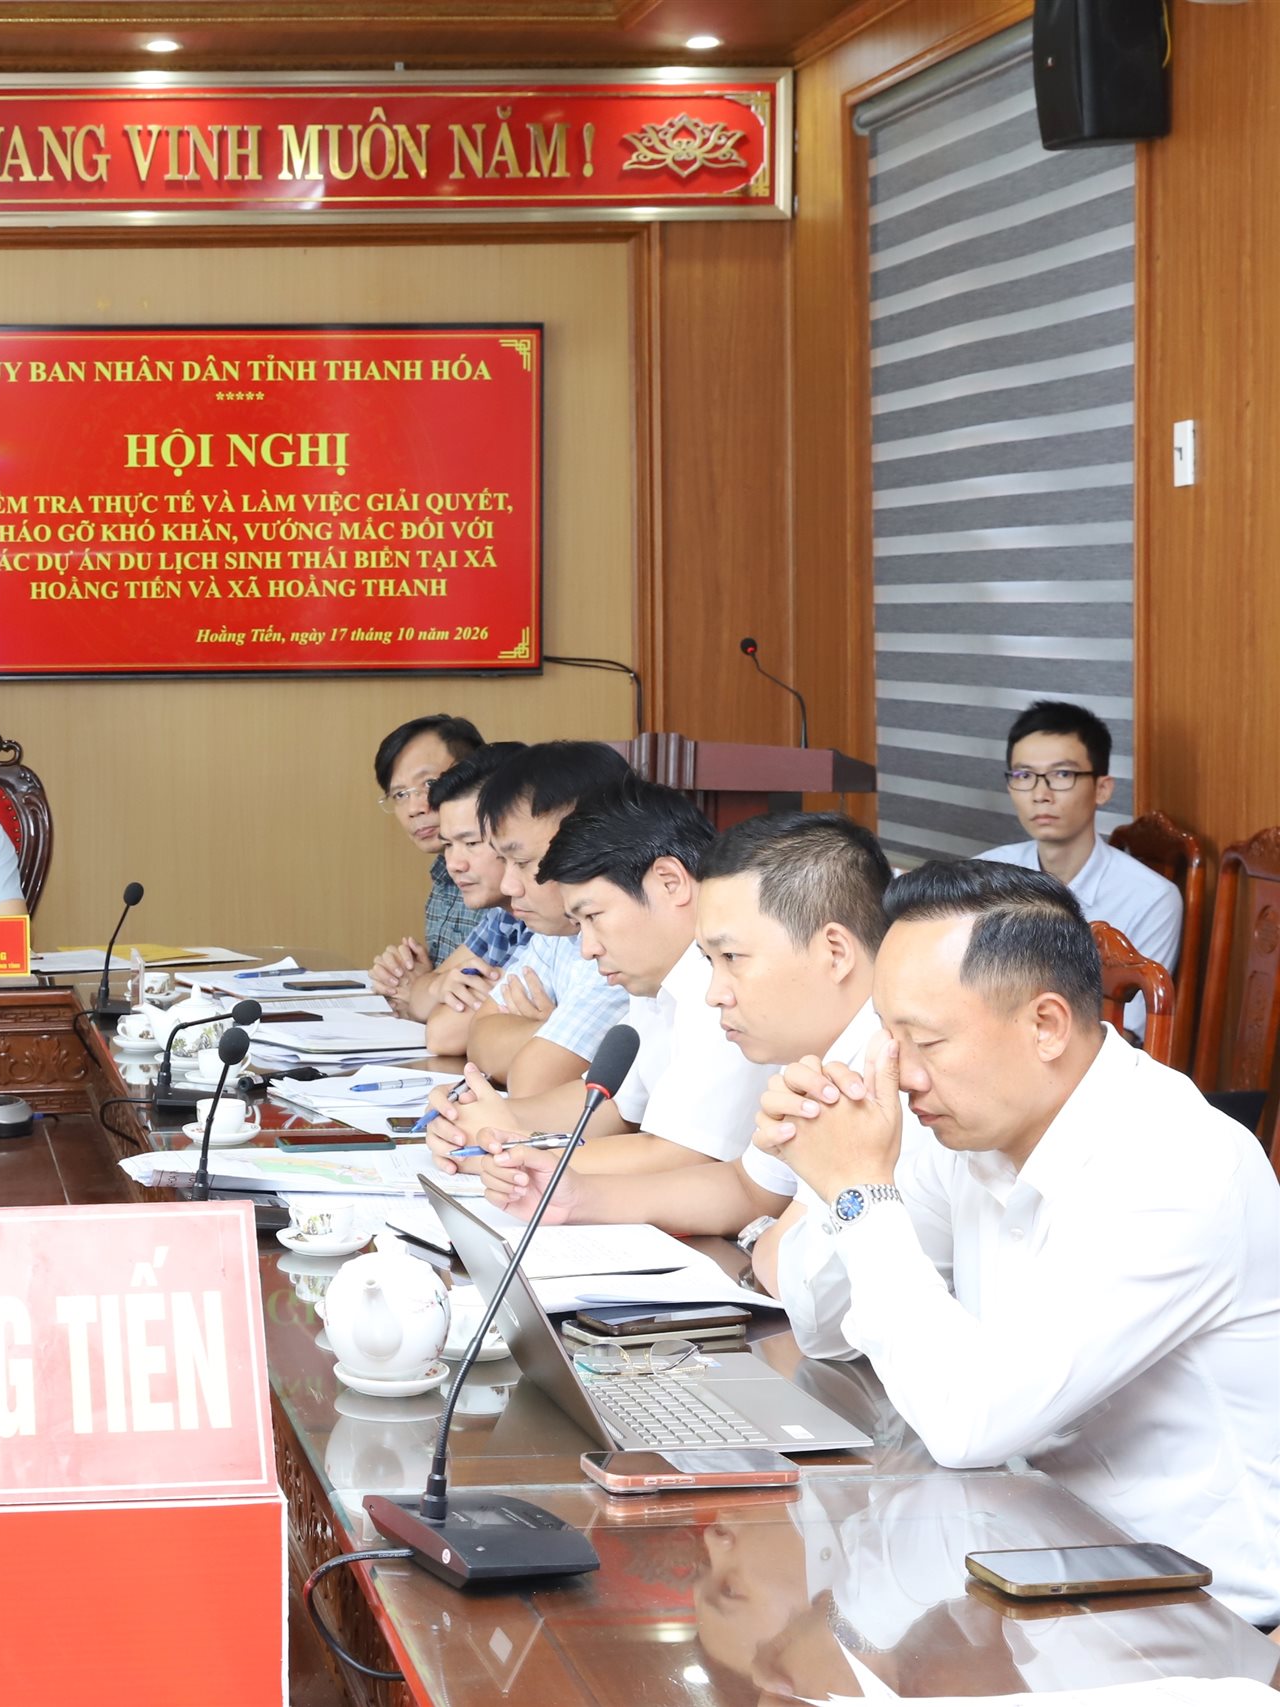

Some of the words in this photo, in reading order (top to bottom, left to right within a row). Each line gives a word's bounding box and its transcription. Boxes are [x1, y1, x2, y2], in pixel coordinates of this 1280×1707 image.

[123, 124, 262, 182] VINH
[278, 106, 431, 181] MUÔN
[448, 105, 571, 180] NĂM
[28, 361, 86, 383] BAN
[93, 355, 174, 383] NHÂN
[182, 354, 241, 382] DÂN
[247, 354, 317, 382] TỈNH
[324, 359, 423, 381] THANH
[431, 354, 492, 381] HÓA
[123, 428, 214, 477] HỘI
[226, 433, 351, 476] NGHỊ
[33, 496, 84, 514] TRA
[88, 493, 159, 518] THỰC
[163, 490, 196, 514] TẾ
[201, 489, 236, 513] VÀ
[241, 490, 296, 513] LÀM
[301, 491, 360, 516] VIỆC
[366, 488, 420, 512] GIẢI
[425, 488, 514, 515] QUYẾT,
[57, 520, 96, 543] GỠ
[100, 519, 156, 542] KHÓ
[162, 518, 239, 545] KHĂN,
[243, 518, 333, 541] VƯỚNG
[338, 516, 395, 541] MẮC
[400, 517, 445, 540] ĐỐI
[450, 516, 494, 540] VỚI
[36, 551, 73, 576] DỰ
[77, 548, 112, 571] ÁN
[118, 552, 153, 571] DU
[158, 552, 218, 575] LỊCH
[224, 551, 282, 570] SINH
[287, 546, 348, 569] THÁI
[354, 546, 411, 569] BIỂN
[415, 549, 458, 573] TẠI
[463, 545, 497, 568] XÃ
[30, 576, 119, 600] HOẰNG
[124, 575, 182, 599] TIẾN
[187, 576, 222, 599] VÀ
[228, 576, 262, 598] XÃ
[268, 574, 356, 598] HOẰNG
[362, 578, 448, 597] THANH
[196, 625, 246, 646] Hoằng
[251, 625, 286, 643] Tiến,
[290, 628, 326, 645] ngày
[330, 628, 348, 641] 17
[350, 627, 393, 645] tháng
[397, 627, 415, 641] 10
[417, 628, 450, 641] năm
[453, 626, 489, 641] 2026
[55, 1245, 233, 1434] TIẾN
